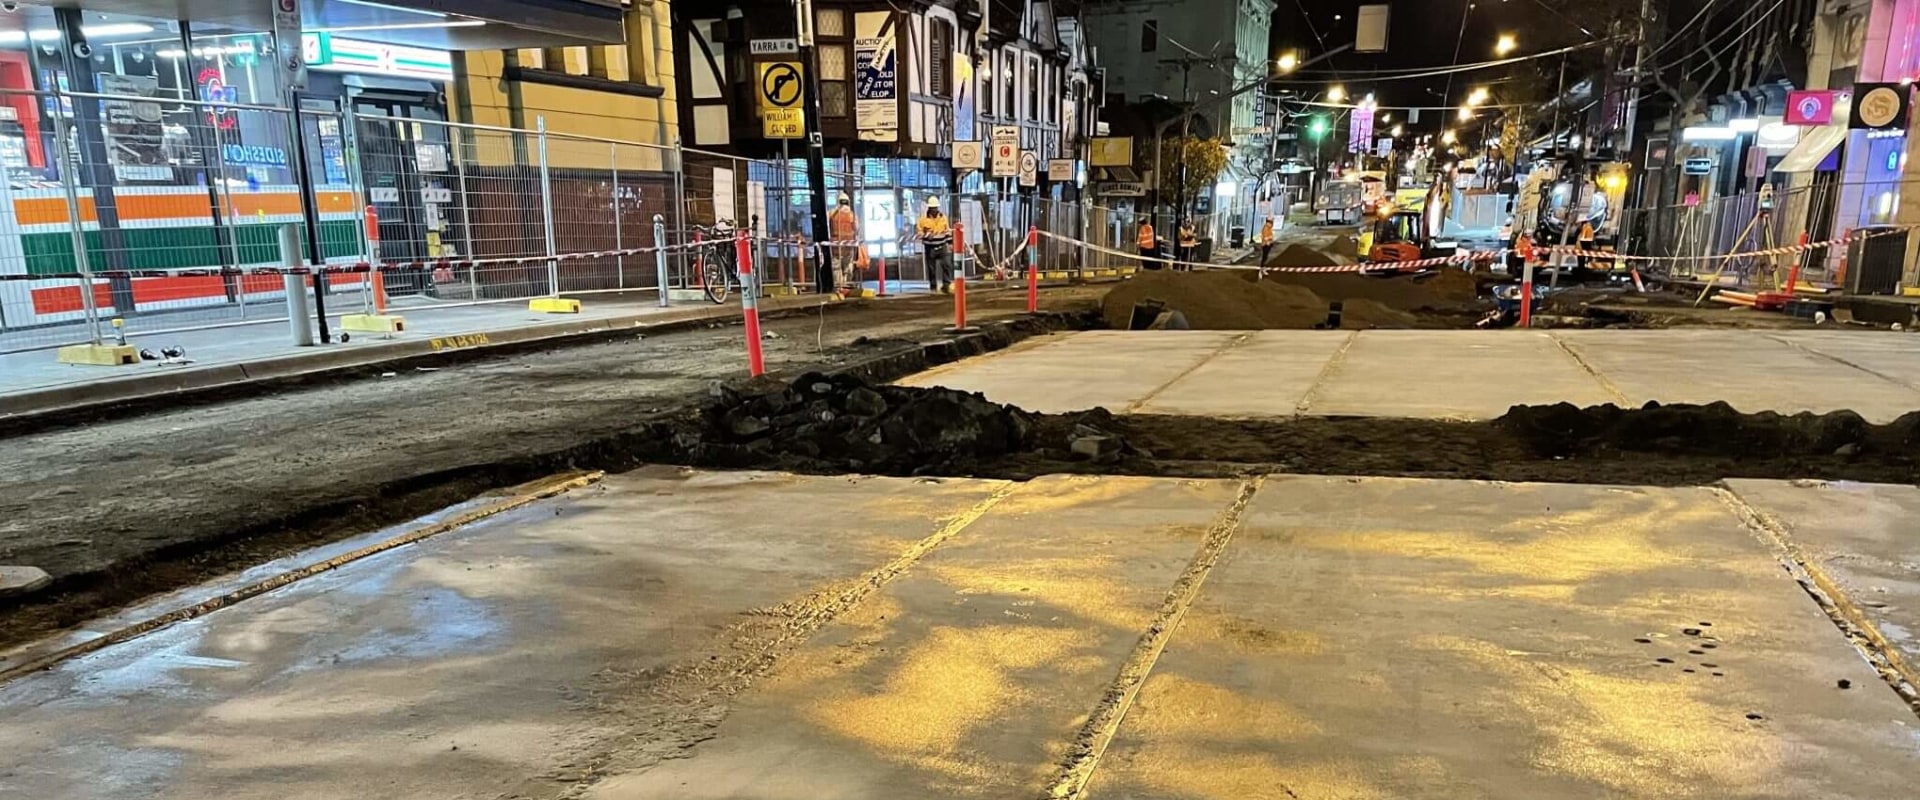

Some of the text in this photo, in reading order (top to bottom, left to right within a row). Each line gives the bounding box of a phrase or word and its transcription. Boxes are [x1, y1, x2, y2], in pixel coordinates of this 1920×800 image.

[752, 41, 778, 52] YARRA
[857, 52, 876, 60] PRIM
[883, 80, 893, 88] OR
[766, 112, 792, 121] WILLIAM
[771, 123, 797, 134] CLOSED
